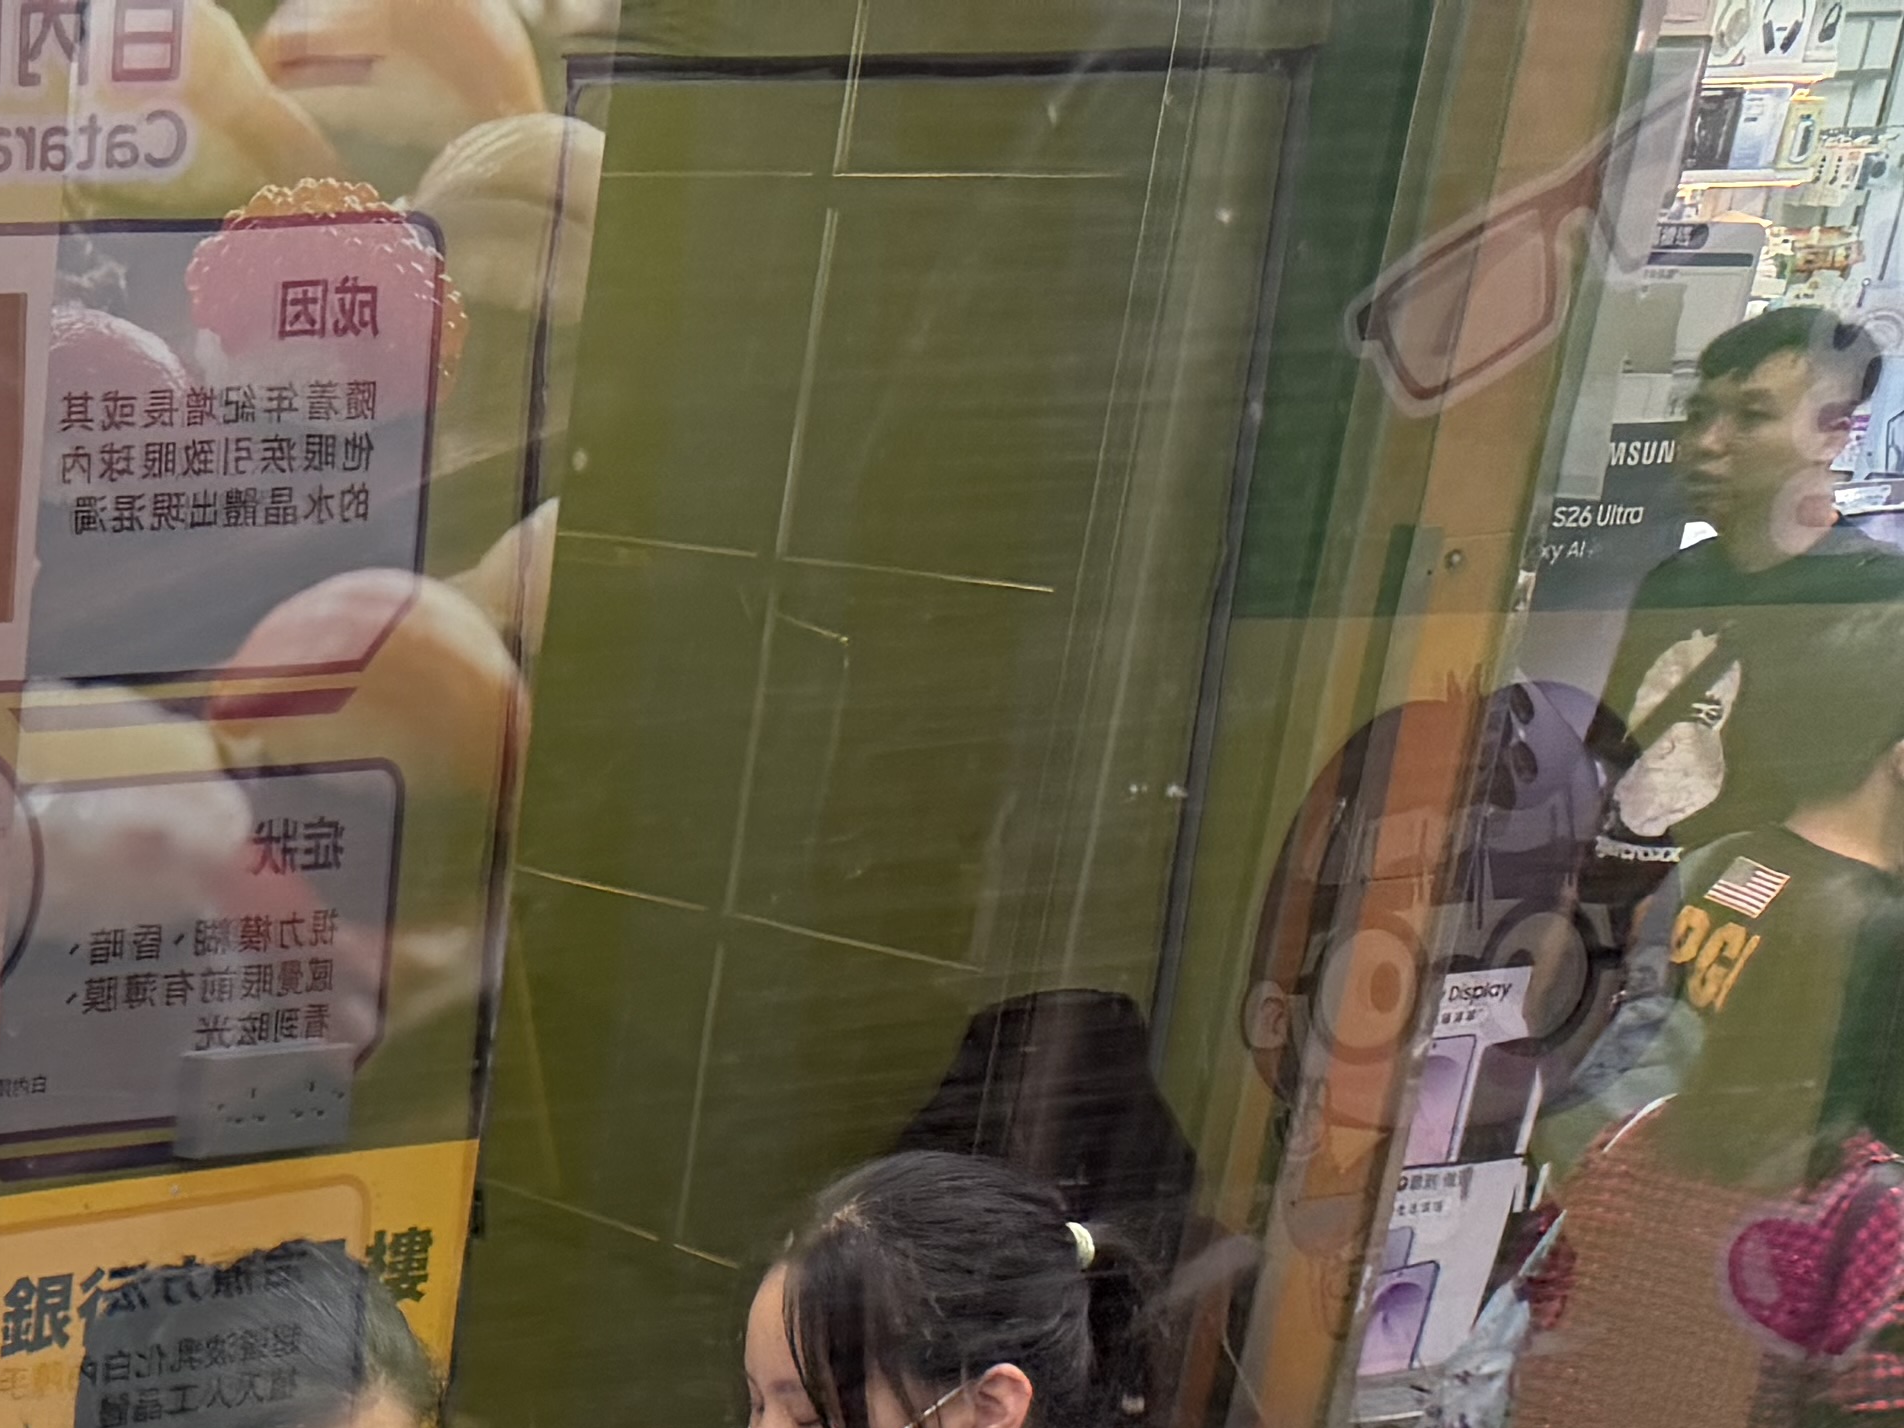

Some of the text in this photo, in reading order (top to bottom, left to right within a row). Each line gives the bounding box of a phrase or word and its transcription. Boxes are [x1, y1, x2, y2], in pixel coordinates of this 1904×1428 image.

[1552, 503, 1644, 528] S26 Ultra
[1448, 981, 1513, 1003] Display
